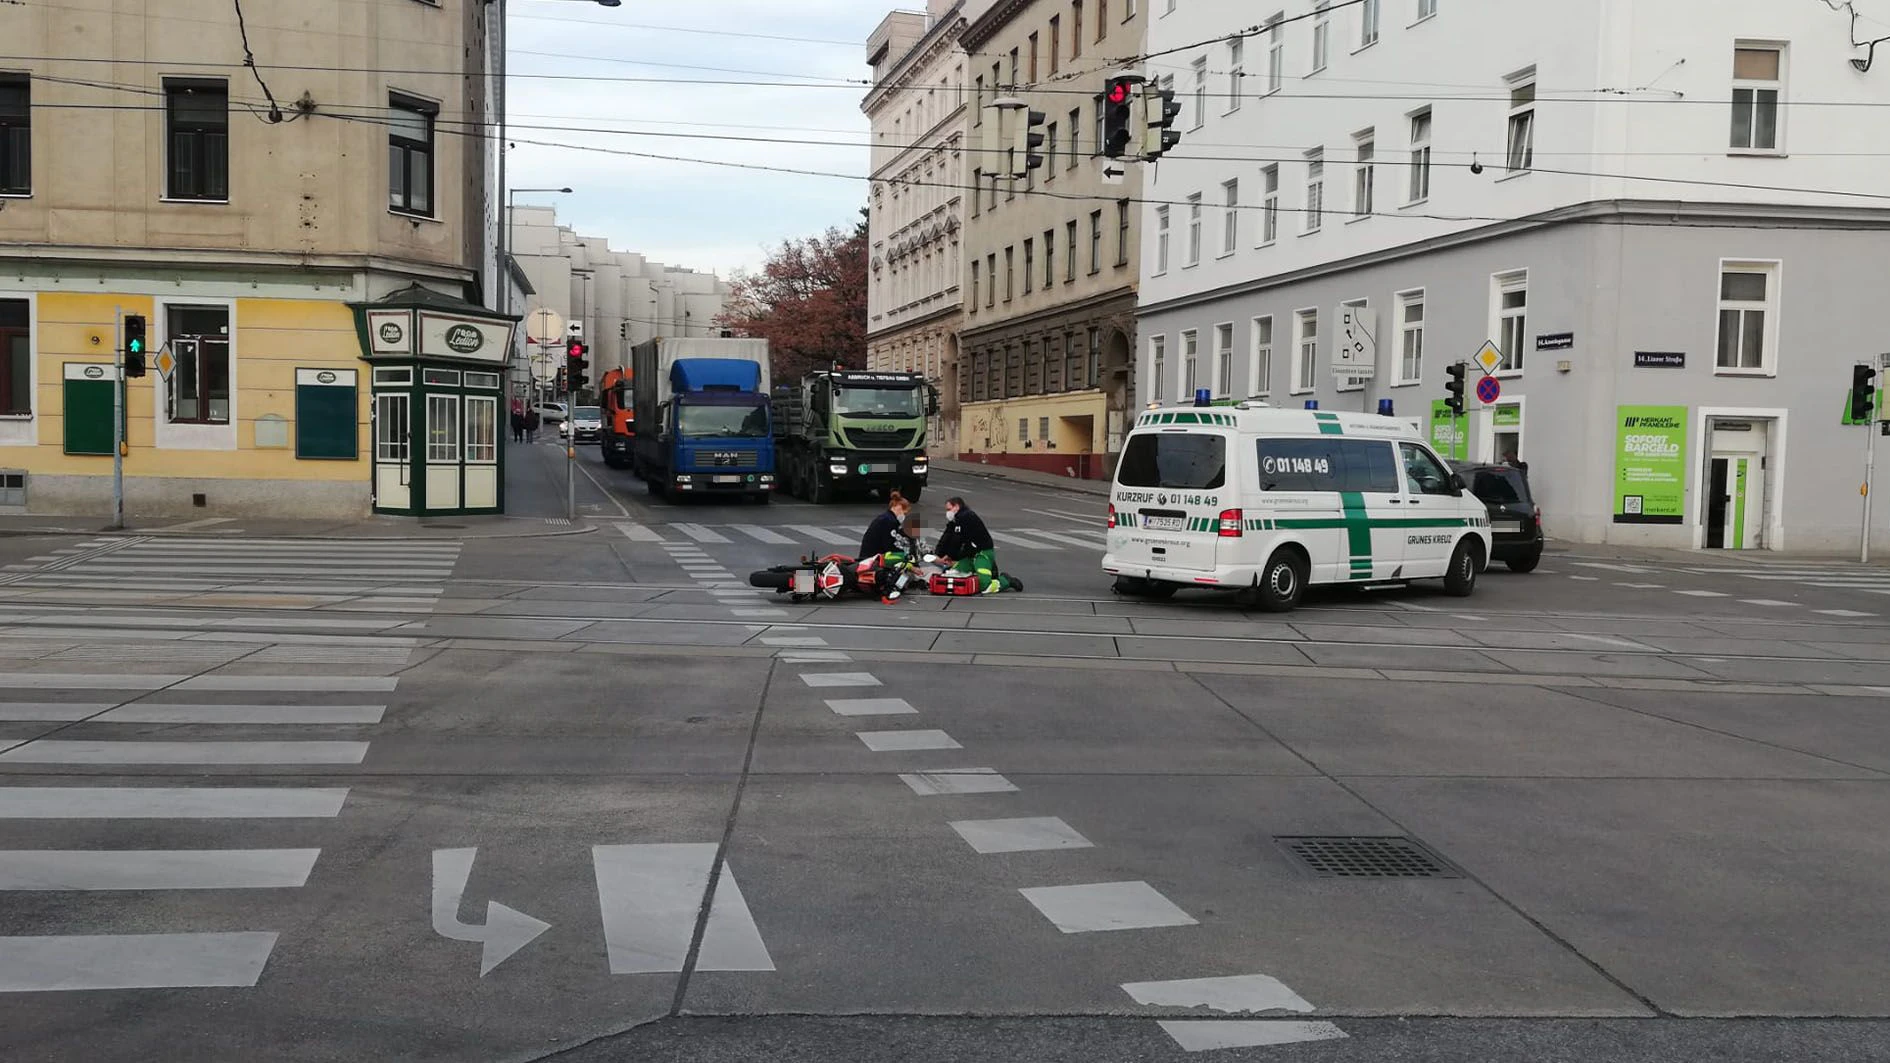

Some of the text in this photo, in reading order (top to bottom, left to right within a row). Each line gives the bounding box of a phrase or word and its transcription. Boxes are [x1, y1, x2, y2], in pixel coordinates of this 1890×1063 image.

[1624, 435, 1669, 444] SOFORT
[1624, 443, 1680, 453] BARGELD
[1276, 457, 1329, 474] 01 148 49
[1116, 491, 1218, 506] KURZRUF 01 148 49
[1433, 534, 1452, 544] KREUZ
